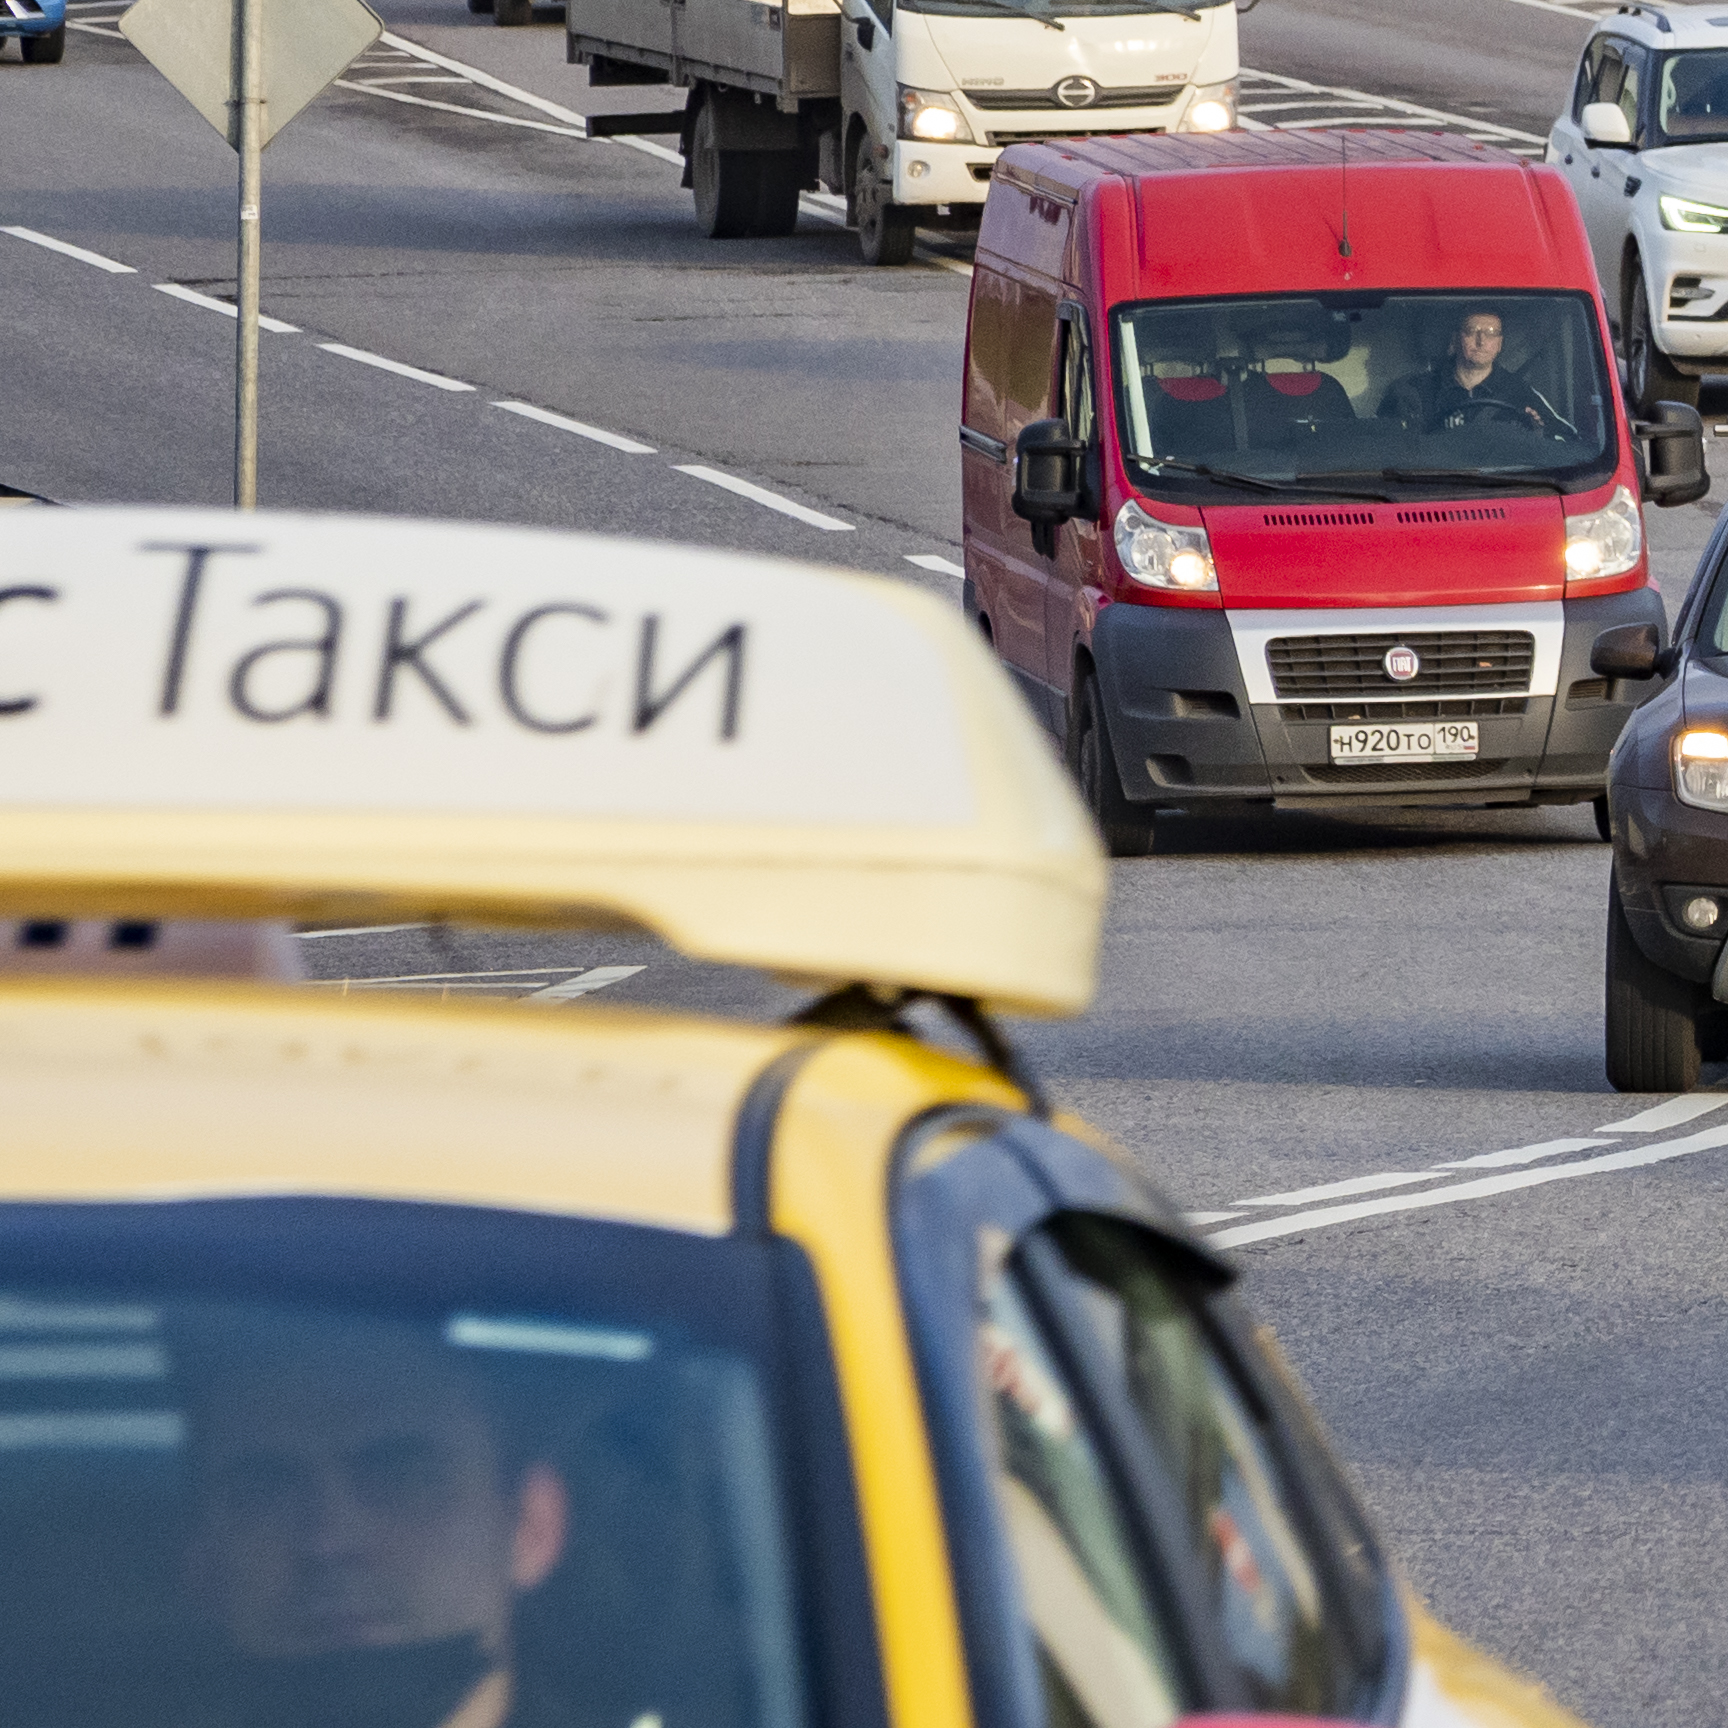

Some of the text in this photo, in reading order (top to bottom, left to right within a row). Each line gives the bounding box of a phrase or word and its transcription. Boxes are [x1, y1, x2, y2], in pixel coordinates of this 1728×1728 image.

[136, 538, 754, 744] Такси
[1340, 725, 1471, 753] Н920ТО 190
